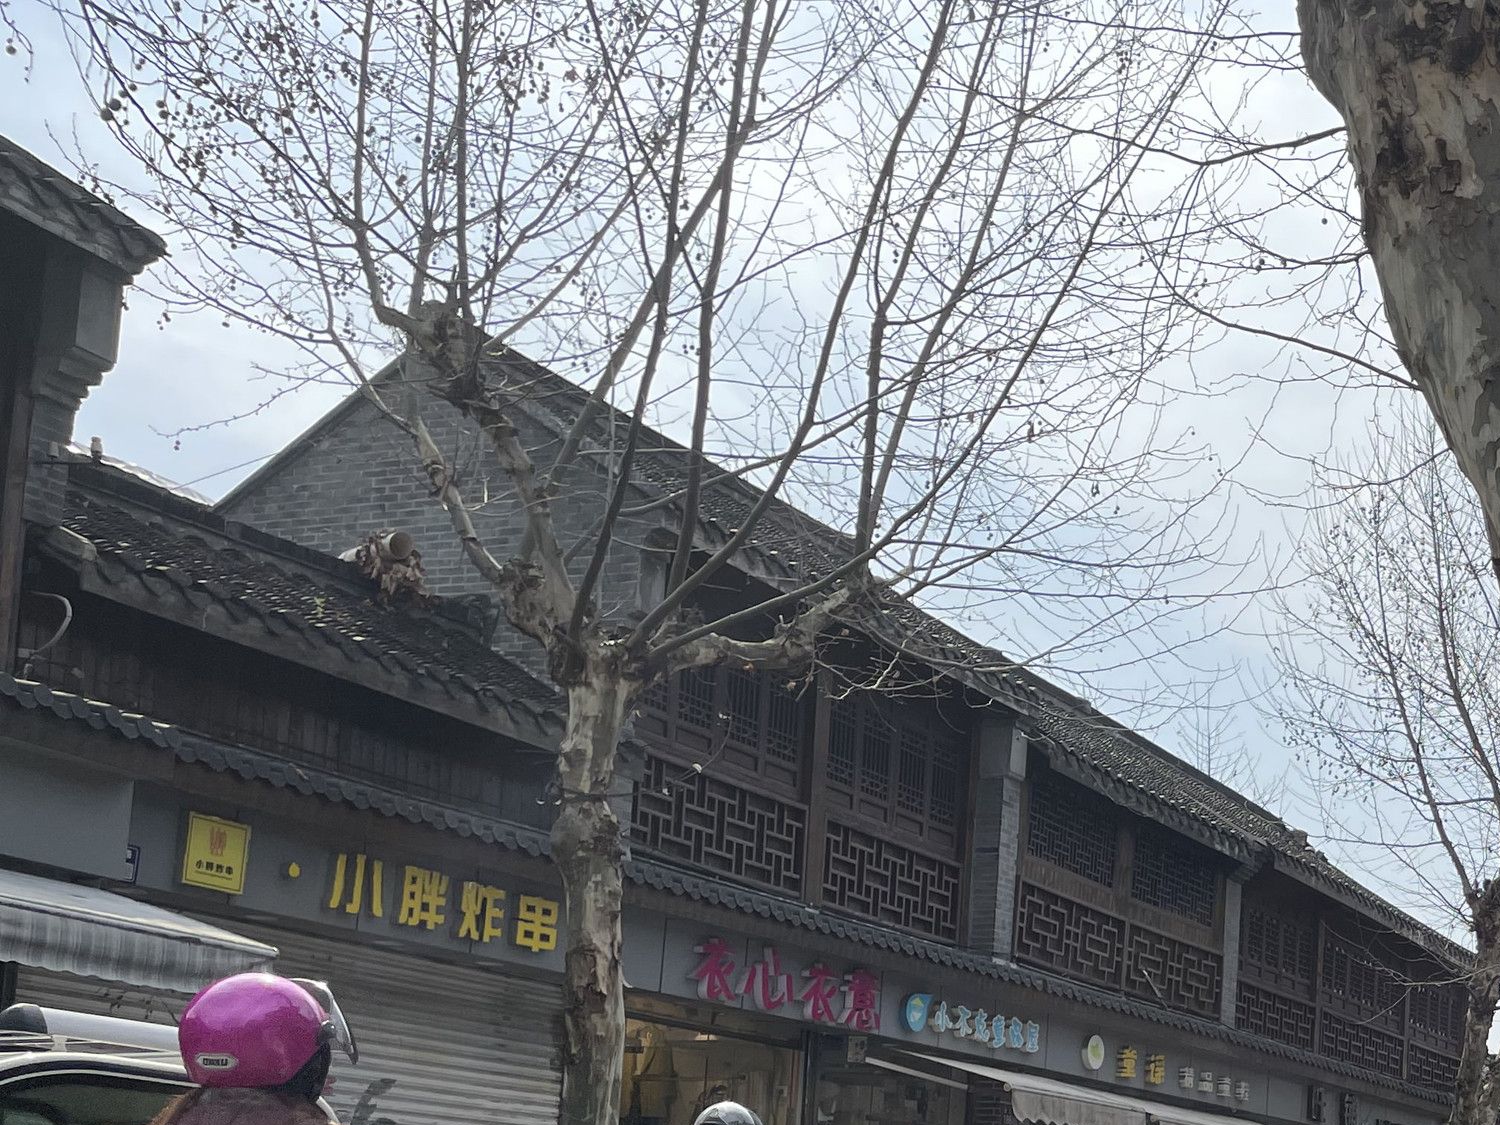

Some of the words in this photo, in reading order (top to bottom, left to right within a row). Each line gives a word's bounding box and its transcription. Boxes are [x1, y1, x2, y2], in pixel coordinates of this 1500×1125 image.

[329, 852, 560, 953] 小胖炸串
[692, 937, 881, 1033] 衣心衣意
